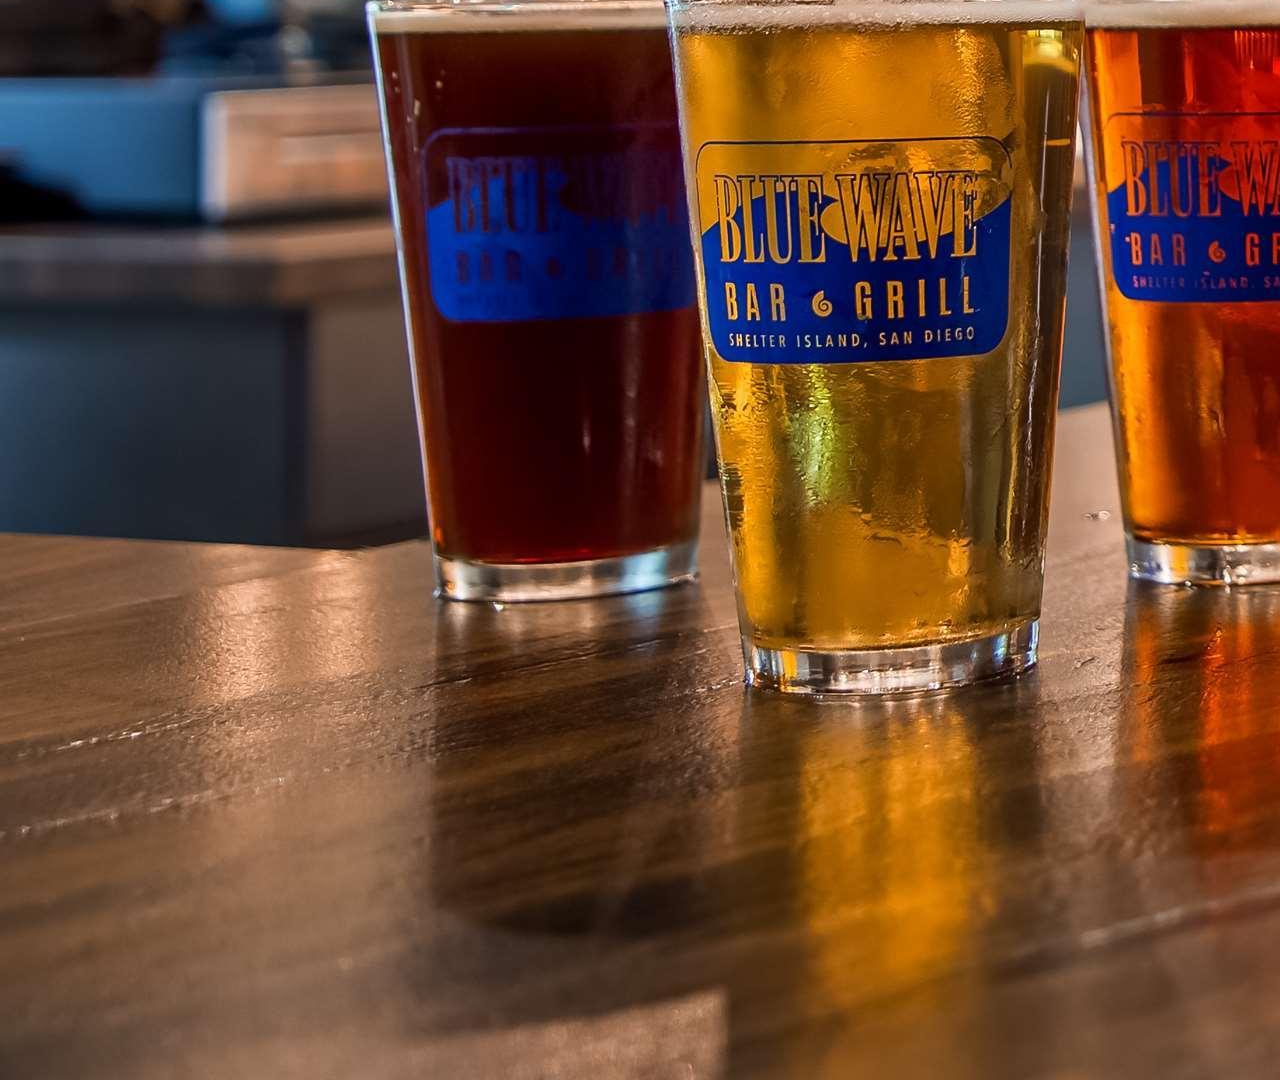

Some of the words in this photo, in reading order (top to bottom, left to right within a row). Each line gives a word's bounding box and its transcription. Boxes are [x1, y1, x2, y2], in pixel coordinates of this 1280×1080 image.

[1121, 139, 1222, 218] BLUE
[713, 174, 827, 264] BLUE
[834, 170, 978, 263] WAVE
[1129, 231, 1187, 266] BAR
[724, 281, 787, 321] BAR
[854, 275, 975, 321] GRILL
[728, 332, 787, 348] SHELTER
[796, 331, 869, 349] ISLAND,
[878, 330, 913, 346] SAN
[924, 325, 976, 344] DIEGO
